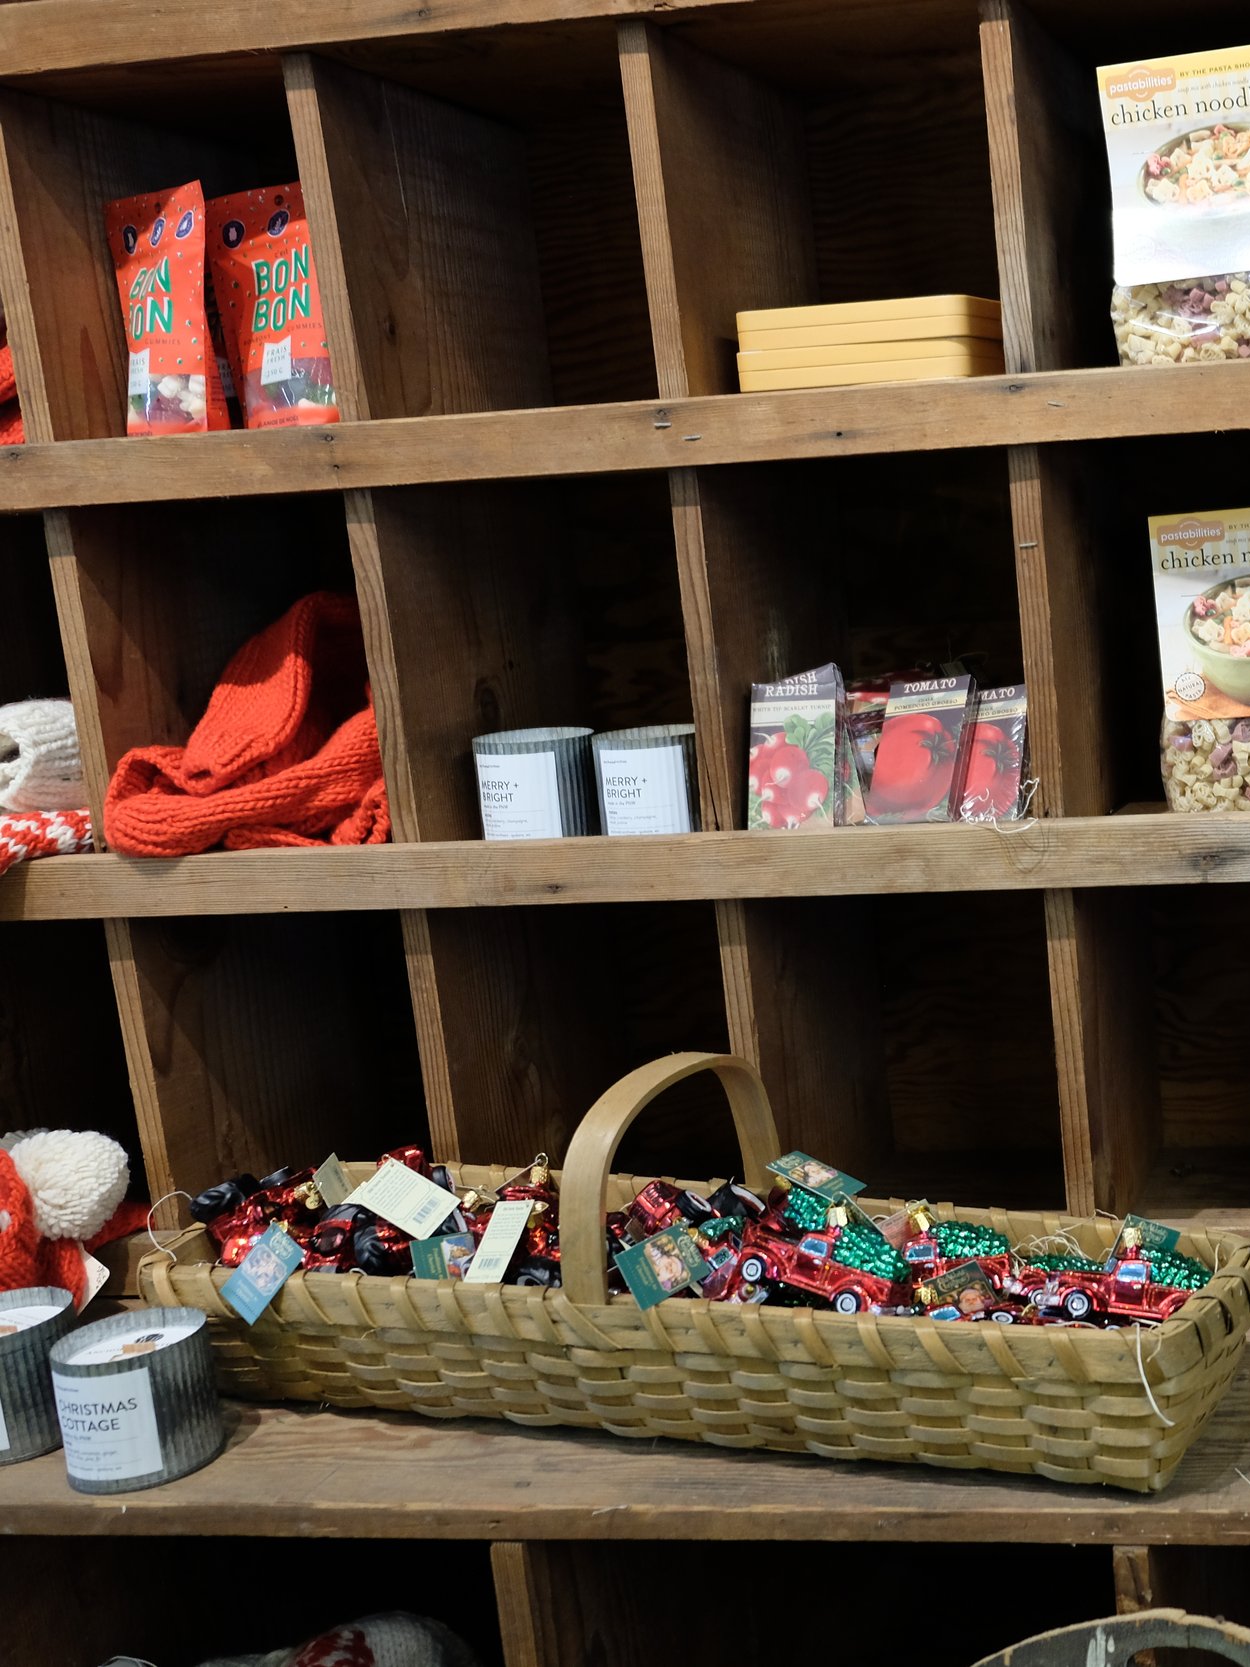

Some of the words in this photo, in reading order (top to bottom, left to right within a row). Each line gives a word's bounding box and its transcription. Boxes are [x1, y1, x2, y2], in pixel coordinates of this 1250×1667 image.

[1209, 64, 1233, 74] PASTA
[1109, 74, 1174, 95] pastabilities
[1111, 100, 1187, 126] chicken
[130, 256, 171, 300] BON
[252, 244, 310, 297] BON
[252, 283, 310, 333] BON
[129, 297, 173, 340] ON
[266, 345, 288, 357] FRAIS
[1160, 526, 1223, 543] pastabilities
[1161, 548, 1234, 570] chicken
[765, 684, 818, 697] RADISH
[903, 678, 957, 694] TOMATO
[1178, 681, 1202, 693] NATURAL
[980, 687, 1015, 701] MATO
[481, 780, 510, 791] MERRY
[606, 776, 638, 787] MERRY
[482, 792, 514, 803] BRIGHT
[607, 788, 642, 798] BRIGHT
[59, 1398, 138, 1417] CHRISTMAS
[62, 1418, 120, 1432] COTTAGE
